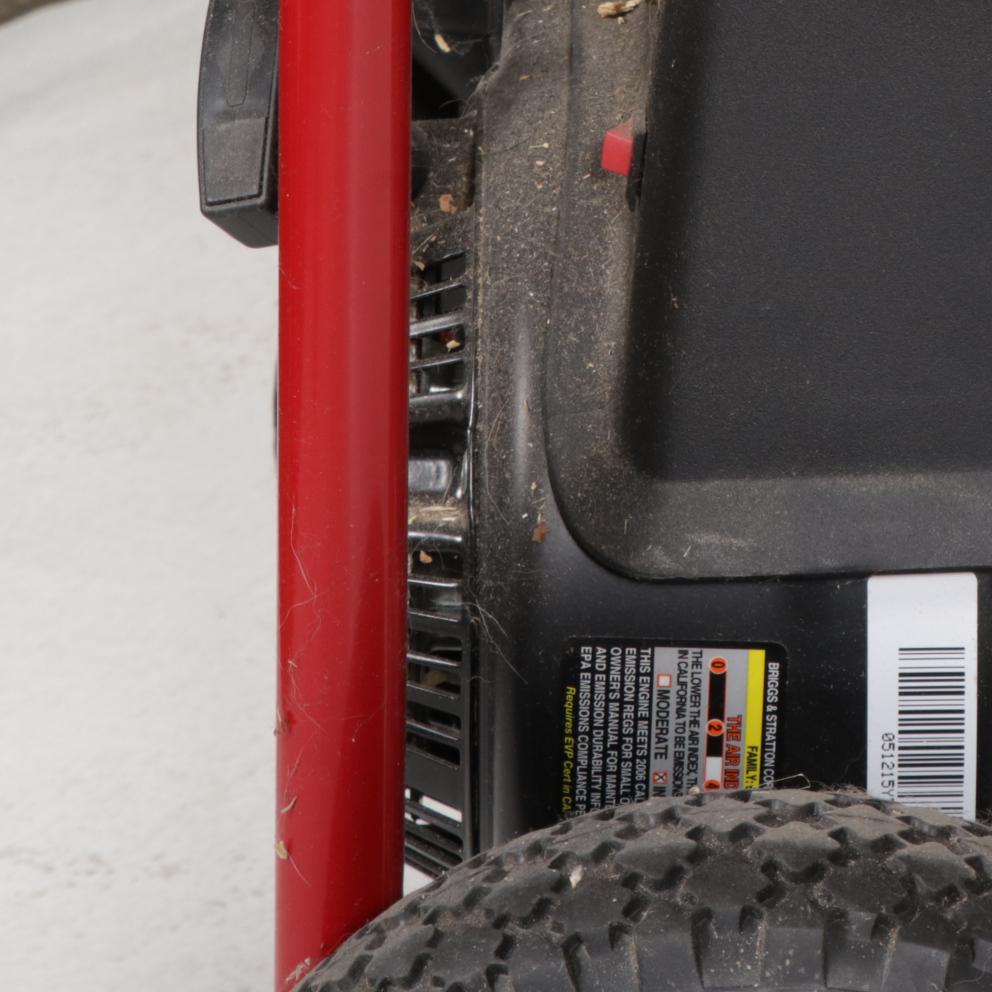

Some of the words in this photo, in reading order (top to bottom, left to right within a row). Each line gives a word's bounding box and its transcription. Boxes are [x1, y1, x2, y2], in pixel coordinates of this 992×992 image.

[580, 646, 592, 669] EPA
[595, 647, 606, 671] AND
[639, 648, 651, 673] THIS
[678, 650, 689, 659] IN
[691, 650, 702, 669] THE
[609, 647, 622, 699] OWNER'S
[623, 648, 637, 701] EMISSION
[766, 662, 779, 703] BRIGGS
[578, 672, 591, 732] EMISSIONS
[593, 674, 605, 726] EMISSION
[638, 676, 650, 718] ENGINE
[676, 662, 688, 719] CALIFORNIA
[689, 672, 702, 708] LOWER
[563, 686, 576, 734] Requires
[607, 702, 619, 748] MANUAL
[622, 704, 635, 734] REGS
[654, 690, 670, 760] MODERATE
[688, 710, 701, 728] THE
[636, 721, 648, 756] MEETS
[674, 736, 685, 749] BE
[675, 722, 686, 734] TO
[688, 730, 699, 746] AIR
[727, 715, 742, 740] THE
[764, 714, 776, 767] STRATTON
[564, 737, 573, 758] EVP
[591, 730, 603, 789] DURABILITY
[607, 751, 617, 772] FOR
[621, 737, 632, 758] FOR
[725, 744, 741, 766] AIR
[563, 761, 573, 782] Cert
[576, 735, 589, 801] COMPLIANCE
[620, 761, 632, 794] SMALL
[635, 758, 646, 781] 2006
[745, 746, 758, 784] FAMILY:
[563, 785, 572, 794] in
